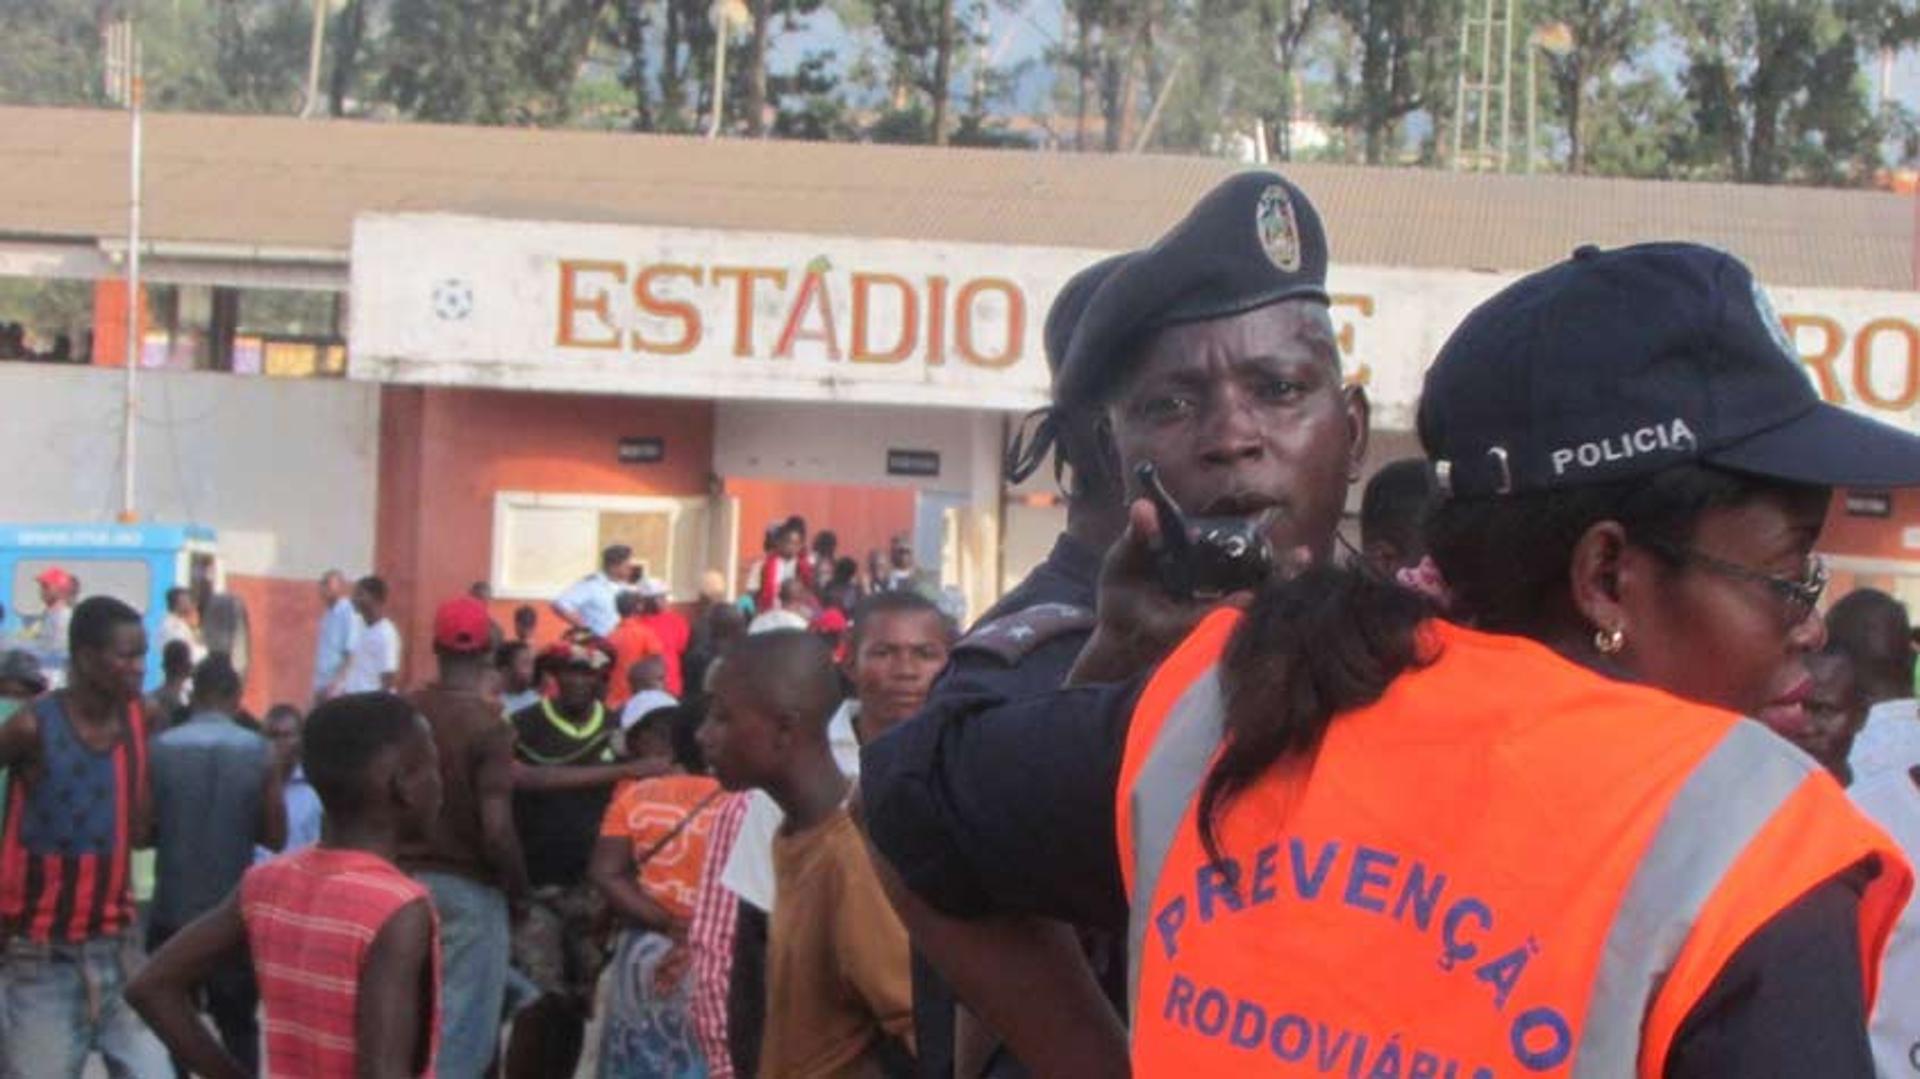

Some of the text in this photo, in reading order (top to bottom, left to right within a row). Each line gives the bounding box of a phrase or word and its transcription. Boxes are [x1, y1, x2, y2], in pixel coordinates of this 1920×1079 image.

[556, 255, 1027, 369] ESTÁDIO
[1551, 417, 1696, 475] POLICIA
[1155, 836, 1573, 1072] PREVENÇÃO
[1163, 974, 1495, 1079] RODOVIÁR
